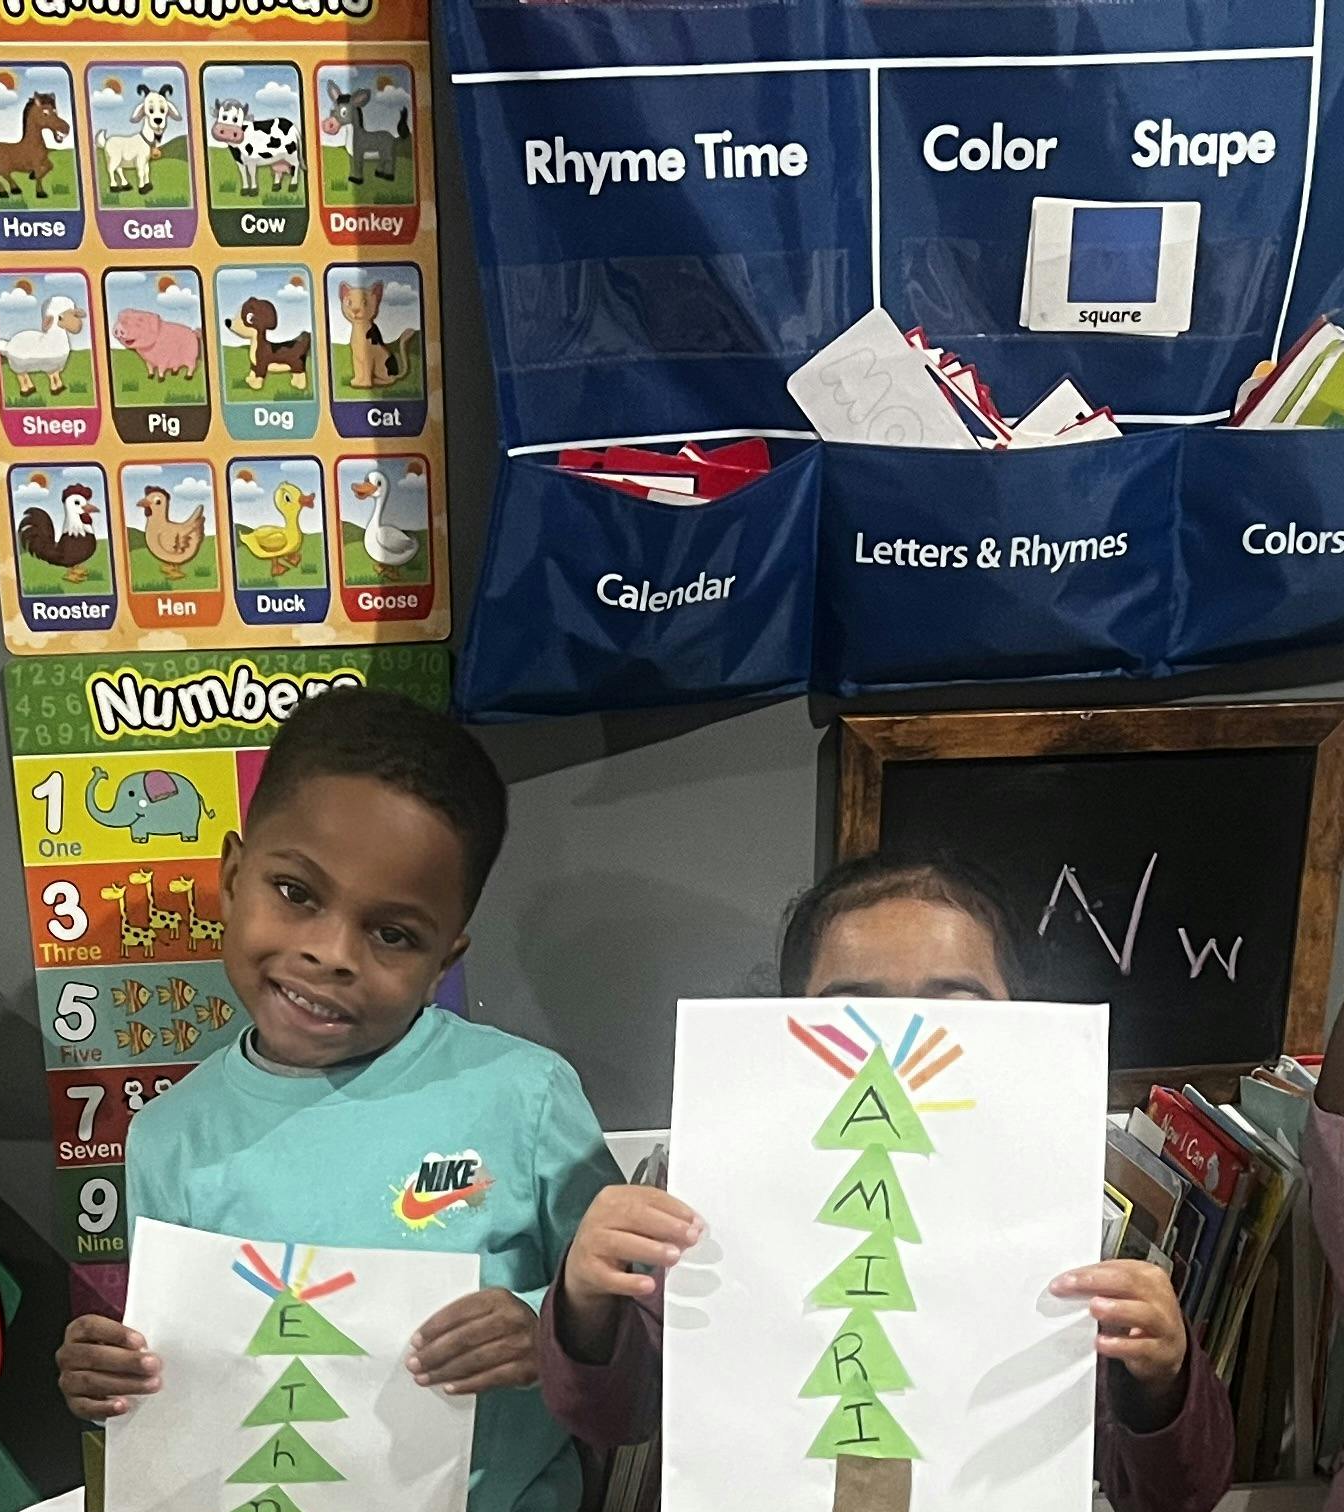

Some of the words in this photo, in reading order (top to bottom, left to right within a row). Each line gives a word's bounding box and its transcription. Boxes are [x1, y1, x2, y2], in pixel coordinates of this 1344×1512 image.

[923, 124, 1057, 173] Color
[1130, 119, 1276, 176] Shape
[524, 137, 685, 194] Rhyme
[694, 131, 808, 180] Time
[4, 217, 66, 238] Horse
[123, 220, 173, 240] Goat
[241, 215, 286, 234] Cow
[331, 214, 403, 235] Donkey
[1078, 308, 1142, 327] square
[23, 416, 86, 438] Sheep
[148, 414, 180, 436] Pig
[254, 408, 293, 431] Dog
[368, 408, 401, 427] Cat
[856, 533, 967, 569] Letters
[976, 538, 1001, 567] &
[1010, 532, 1128, 573] Rhymes
[257, 594, 305, 613] Duck
[358, 592, 418, 611] Goose
[596, 573, 735, 613] Calendar
[32, 601, 109, 621] Rooster
[158, 598, 196, 617] Hen
[32, 770, 64, 835] 1
[38, 839, 82, 858] One
[41, 880, 89, 942] 3
[40, 942, 102, 962] Three
[53, 982, 98, 1042] 5
[60, 1045, 102, 1063] Five
[66, 1085, 105, 1142] 7
[60, 1141, 122, 1160] Seven
[415, 1159, 478, 1193] NIKE
[78, 1178, 119, 1234] 9
[78, 1234, 124, 1252] Nine
